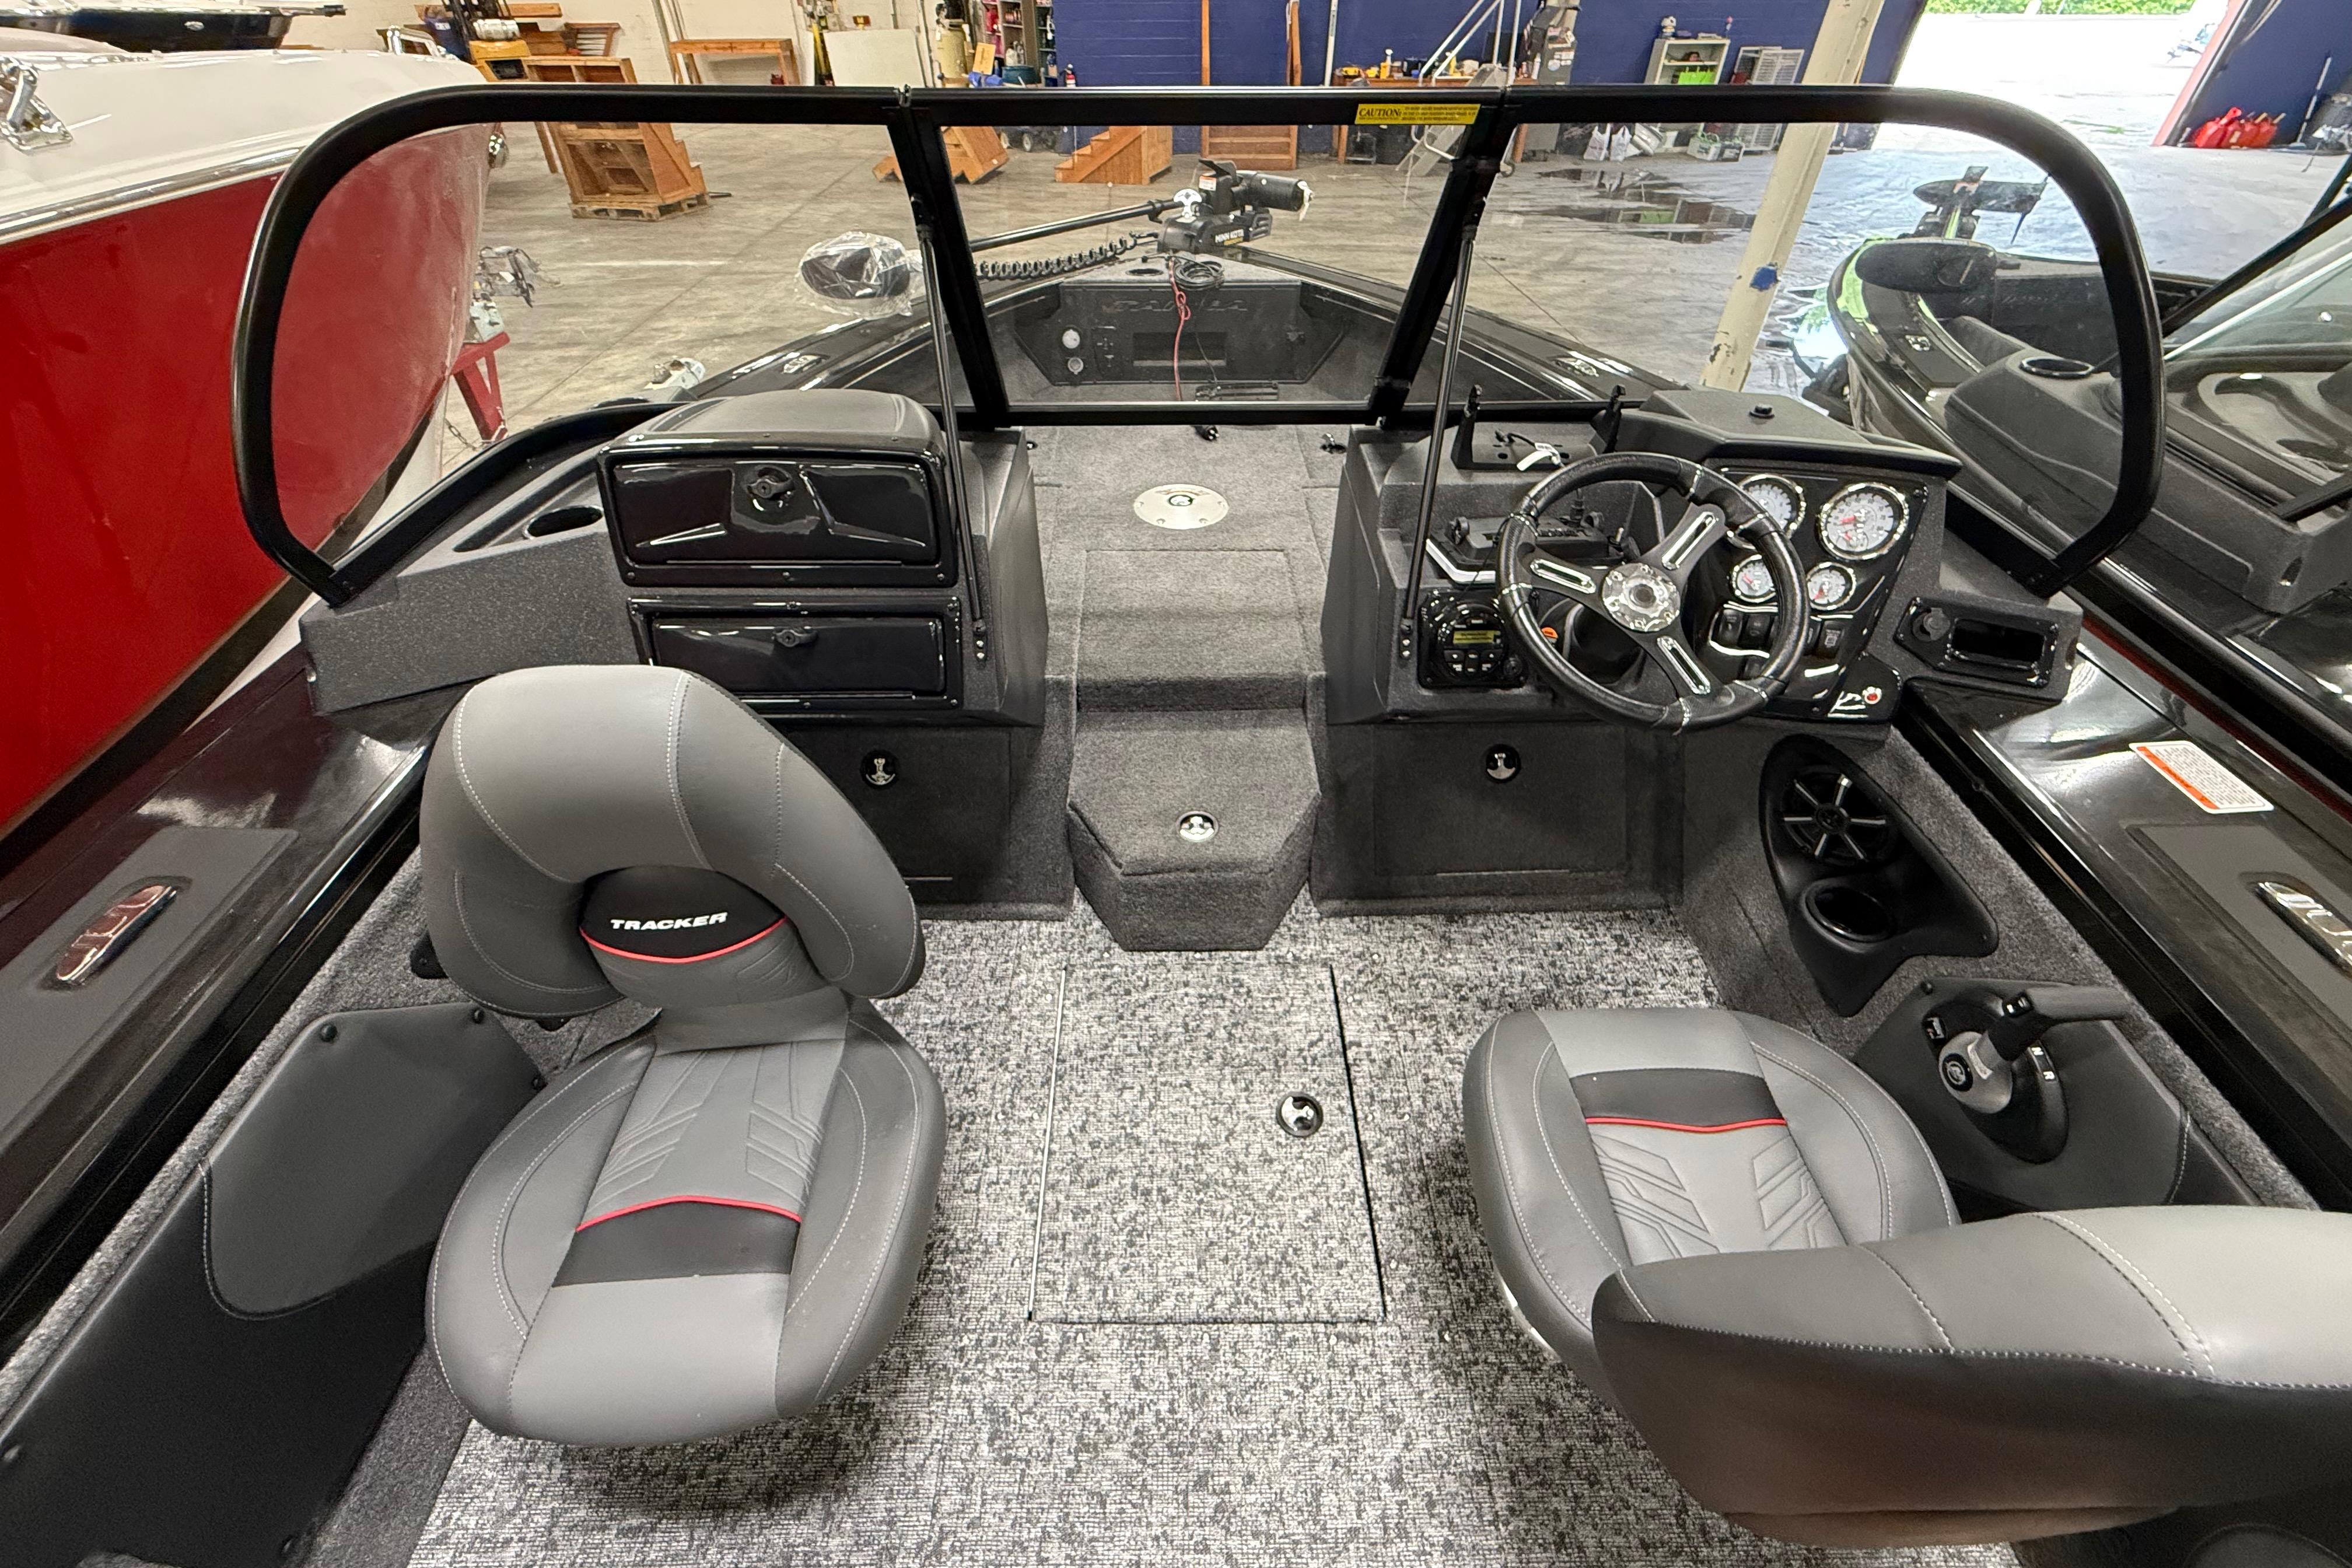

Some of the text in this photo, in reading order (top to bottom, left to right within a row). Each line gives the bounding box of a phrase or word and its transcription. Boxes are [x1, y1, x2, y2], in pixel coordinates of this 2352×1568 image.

[1214, 232, 1230, 243] MINN
[610, 912, 728, 930] TRACKER
[2032, 1047, 2044, 1055] N
